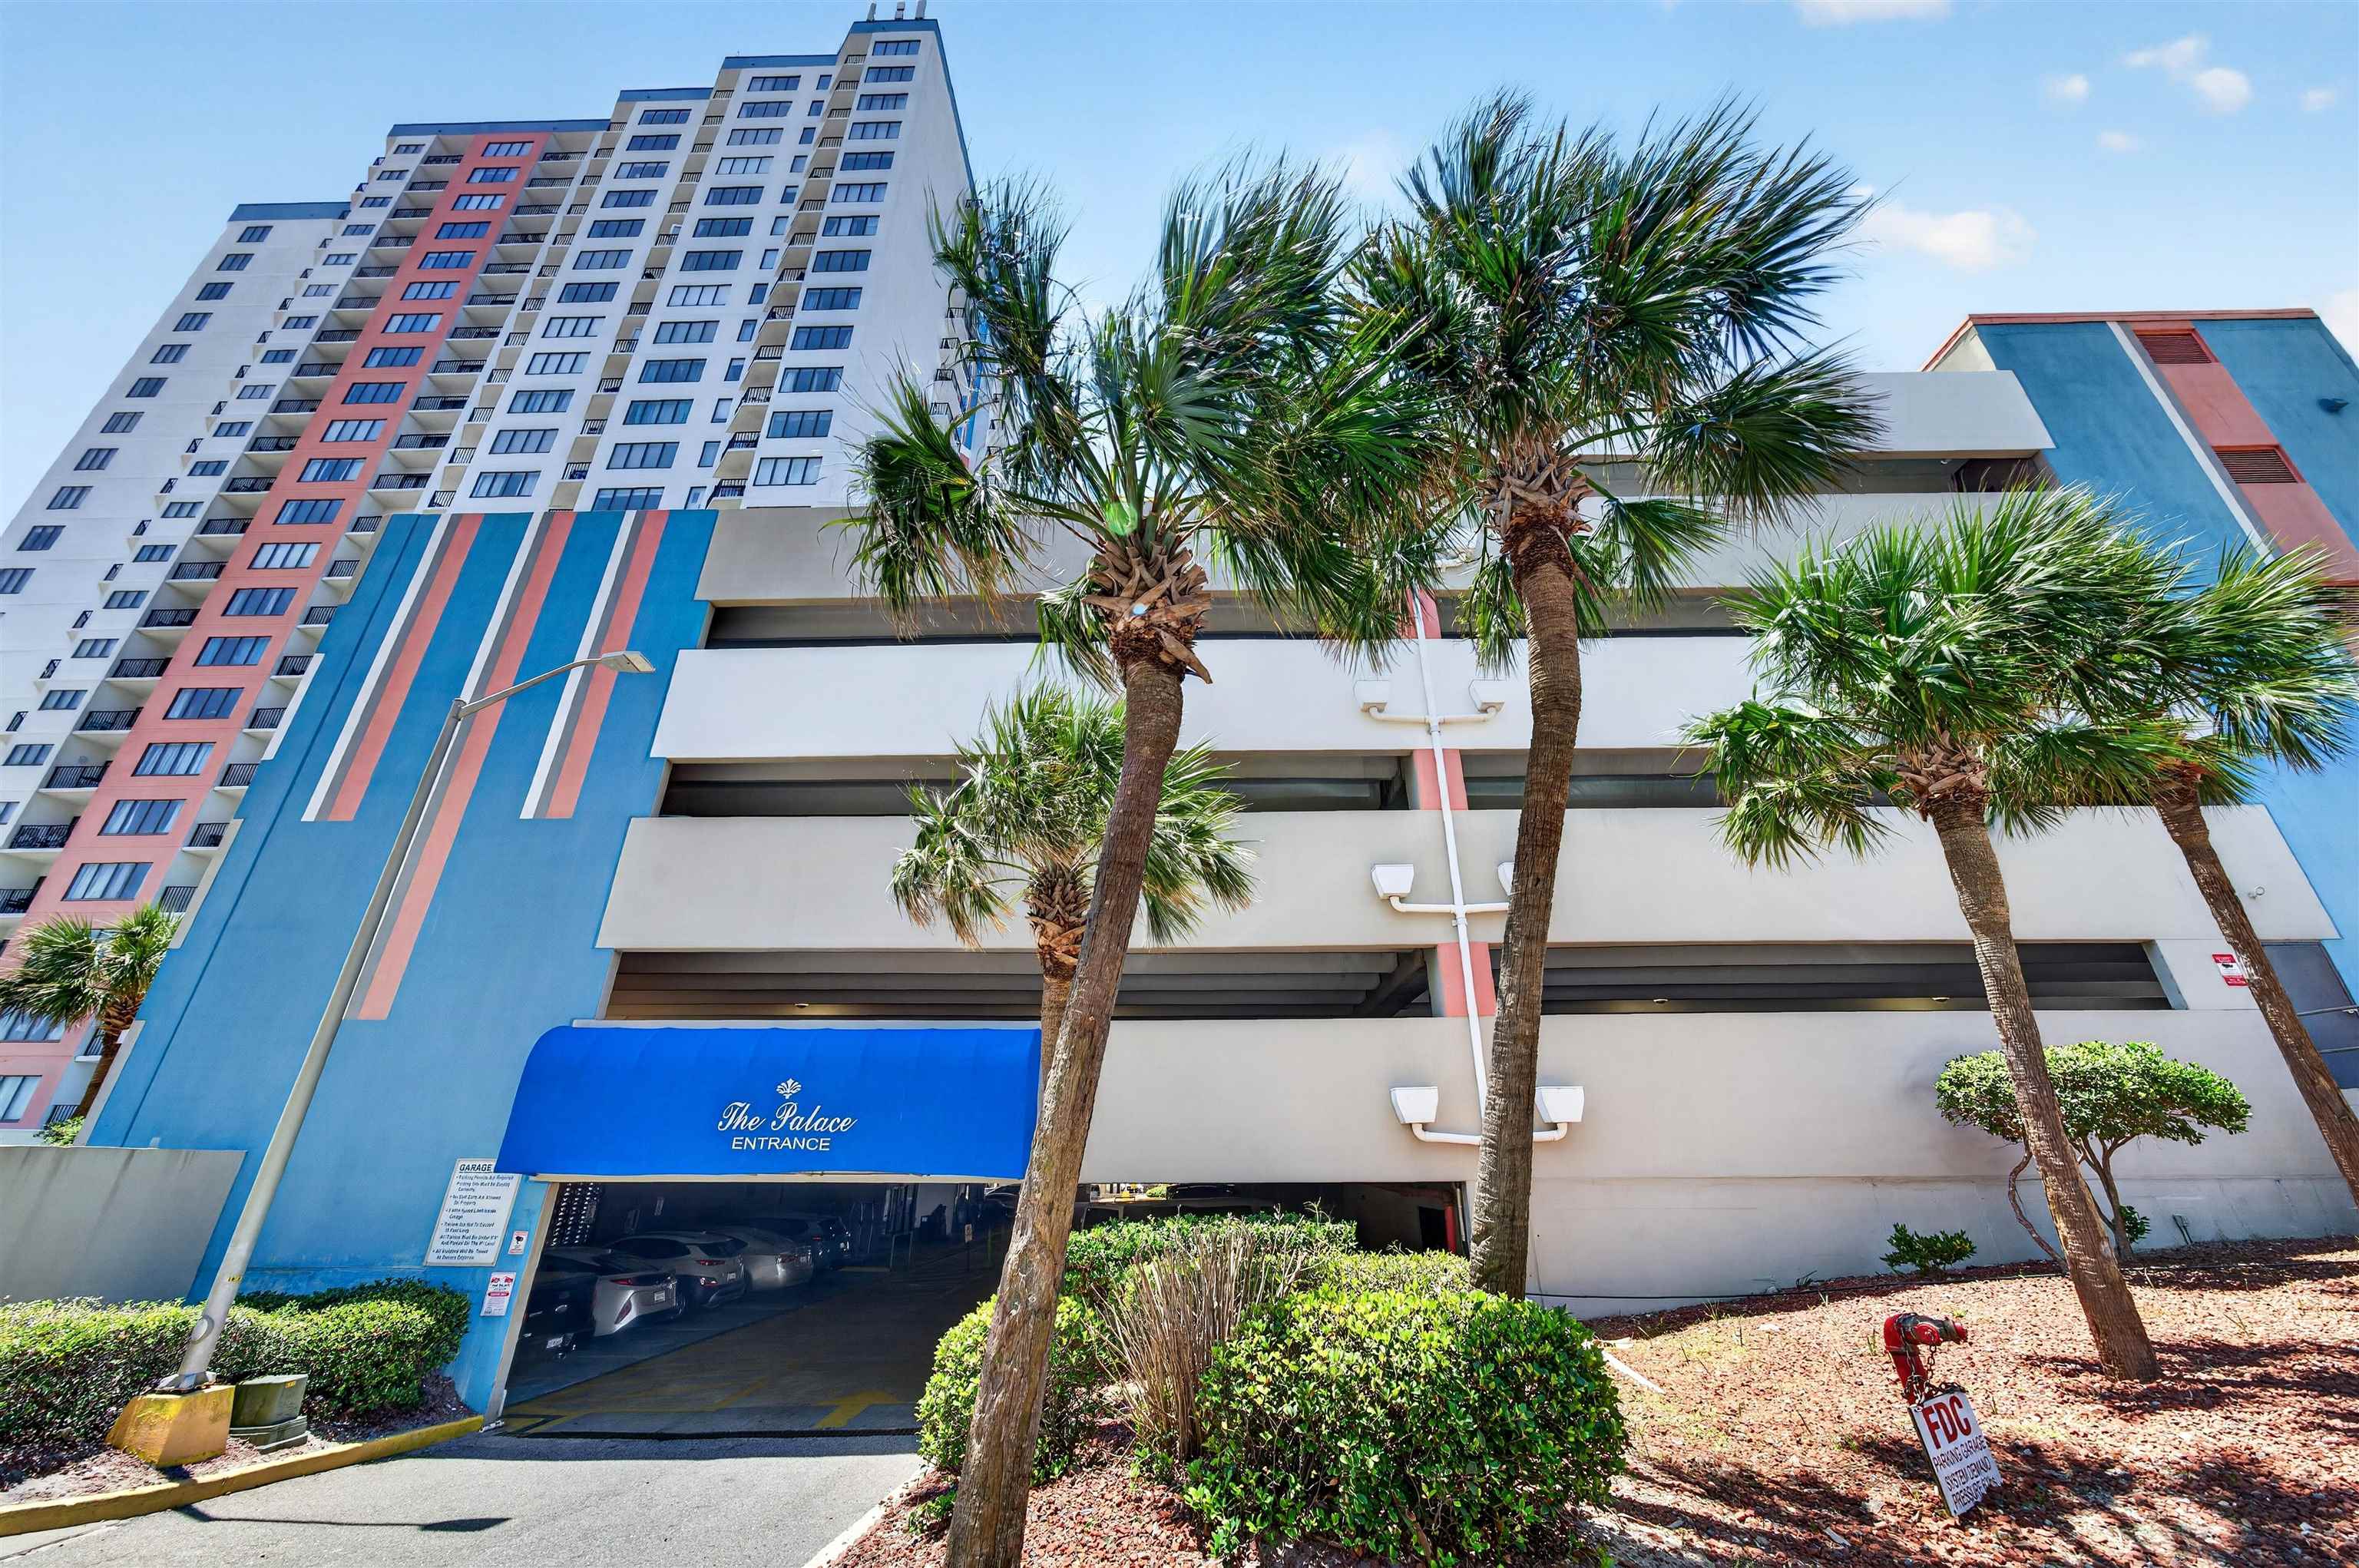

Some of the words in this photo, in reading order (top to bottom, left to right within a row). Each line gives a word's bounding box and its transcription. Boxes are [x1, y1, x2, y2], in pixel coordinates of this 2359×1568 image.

[718, 1102, 766, 1131] The
[771, 1102, 858, 1133] Palace
[732, 1136, 831, 1151] ENTRANCE
[459, 1163, 492, 1172] GARAGE
[1922, 1395, 1971, 1450] FDC
[1932, 1447, 1963, 1472] PARKING
[1960, 1434, 1987, 1458] GARAGE
[1944, 1467, 1967, 1491] SYSTEM
[1967, 1456, 1991, 1480] DEMAND
[1951, 1480, 1983, 1510] PRESSURE
